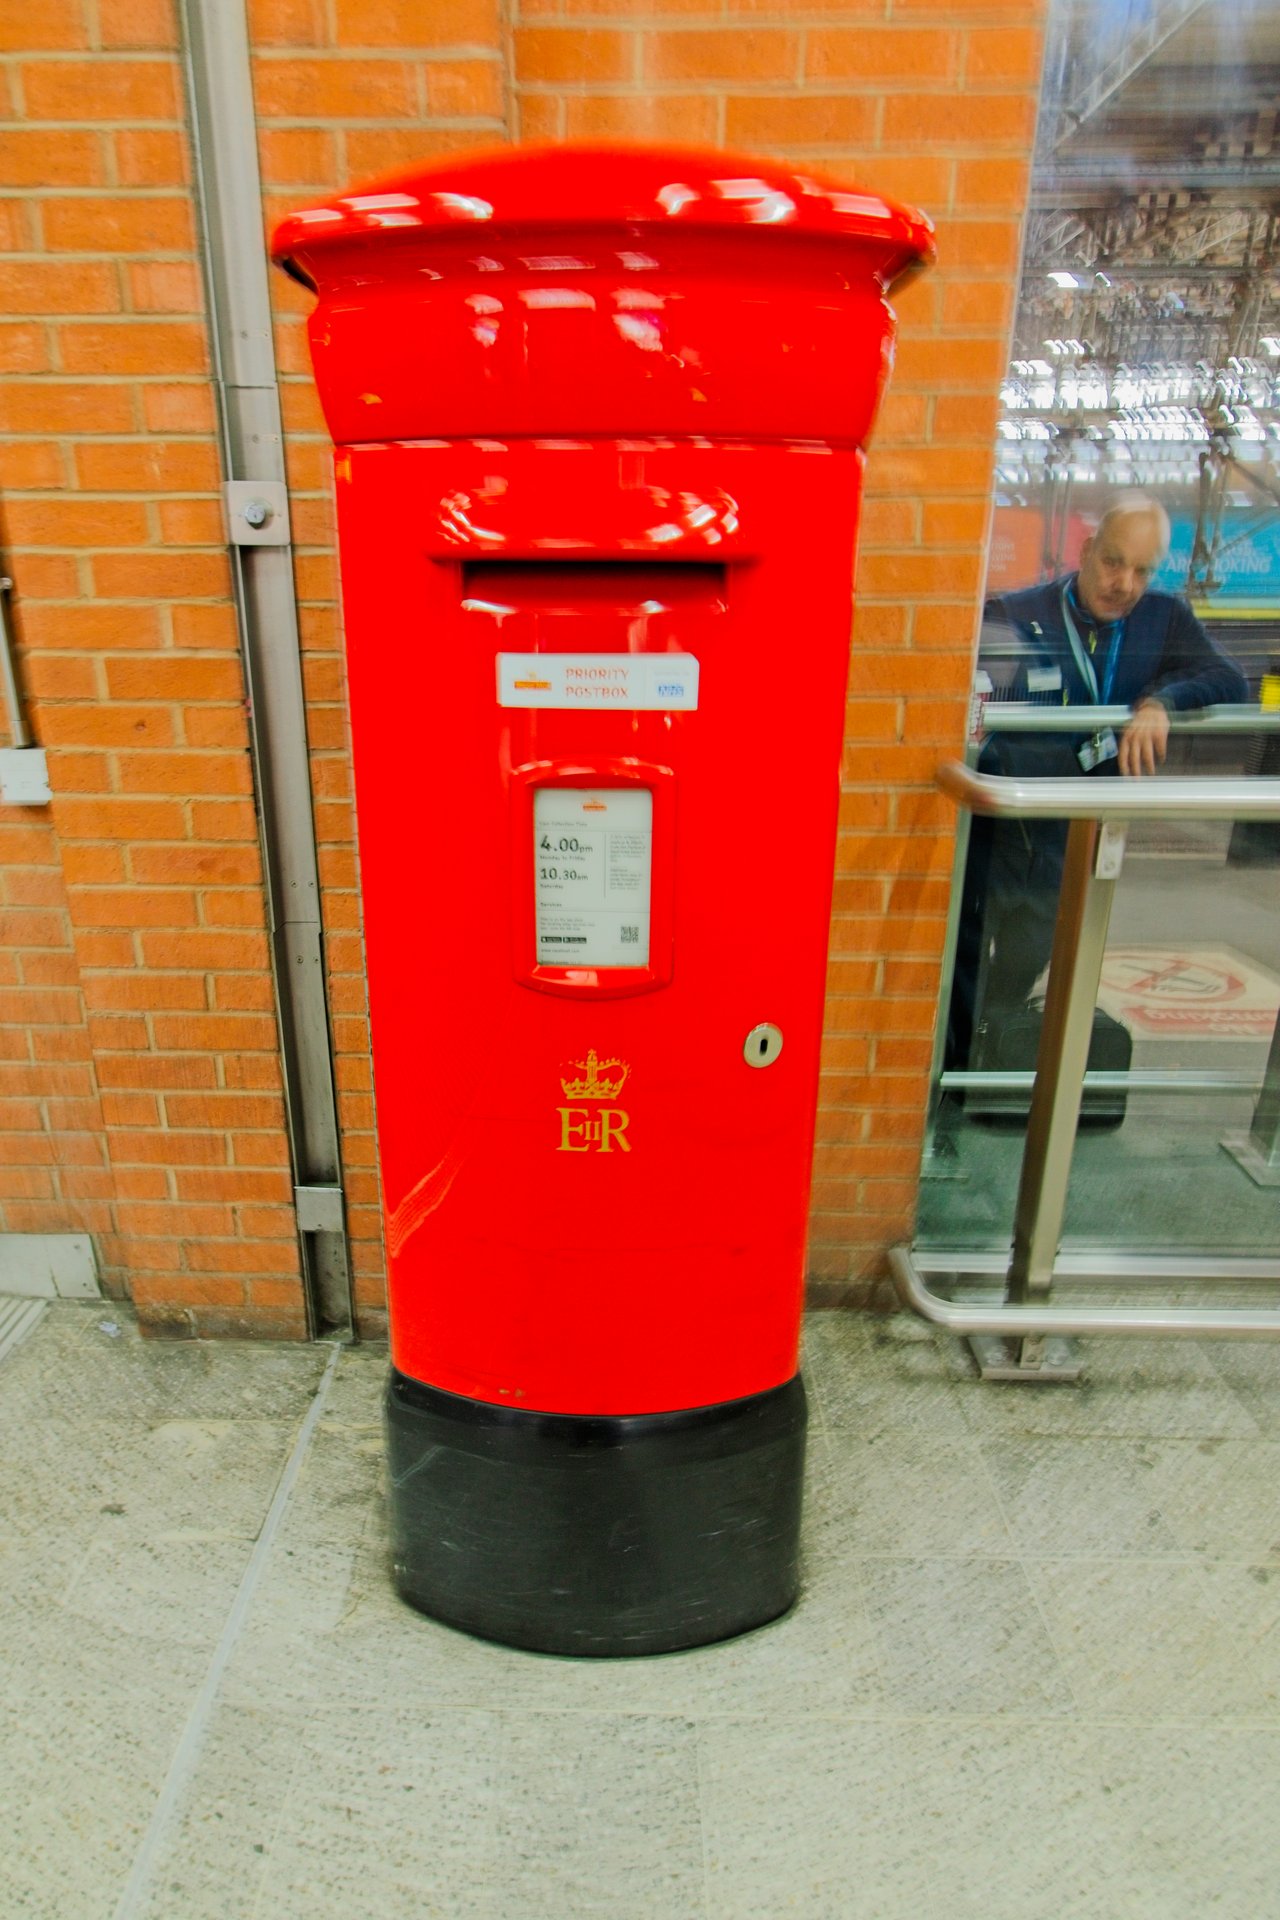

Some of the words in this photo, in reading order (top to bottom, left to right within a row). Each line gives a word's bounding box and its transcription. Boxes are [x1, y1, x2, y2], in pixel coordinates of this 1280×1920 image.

[565, 667, 630, 681] PRIORITY
[565, 686, 630, 699] POSTBOX
[540, 835, 593, 853] 4.00pm
[540, 867, 589, 881] 10.30am
